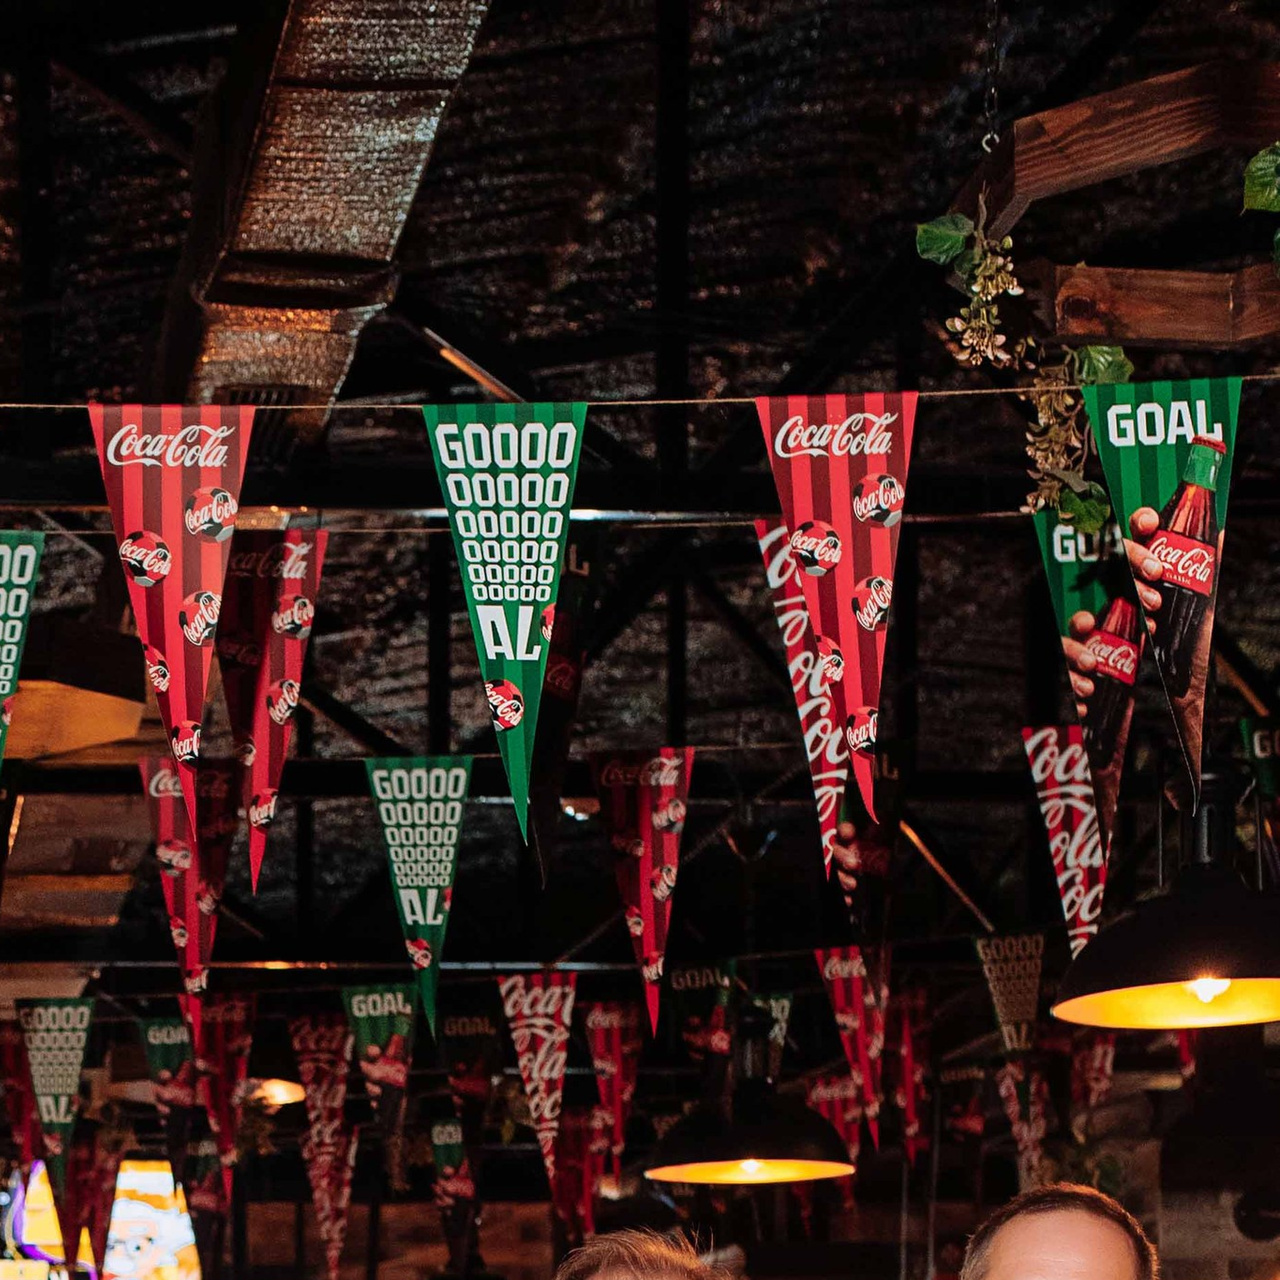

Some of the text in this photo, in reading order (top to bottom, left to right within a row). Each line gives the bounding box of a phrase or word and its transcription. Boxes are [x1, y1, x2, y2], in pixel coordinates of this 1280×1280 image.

[774, 412, 898, 458] Coca-Cola
[1107, 399, 1223, 447] GOAL
[107, 424, 236, 467] Coca-Cola
[435, 422, 577, 469] GOOOO
[446, 472, 569, 508] OOOOO
[455, 510, 563, 538] OOOOO
[462, 540, 559, 563] OOOOO
[468, 564, 555, 584] OOOOO
[476, 605, 541, 661] AL
[372, 767, 467, 800] GOOOO
[399, 888, 444, 925] AL
[351, 993, 411, 1017] GOAL
